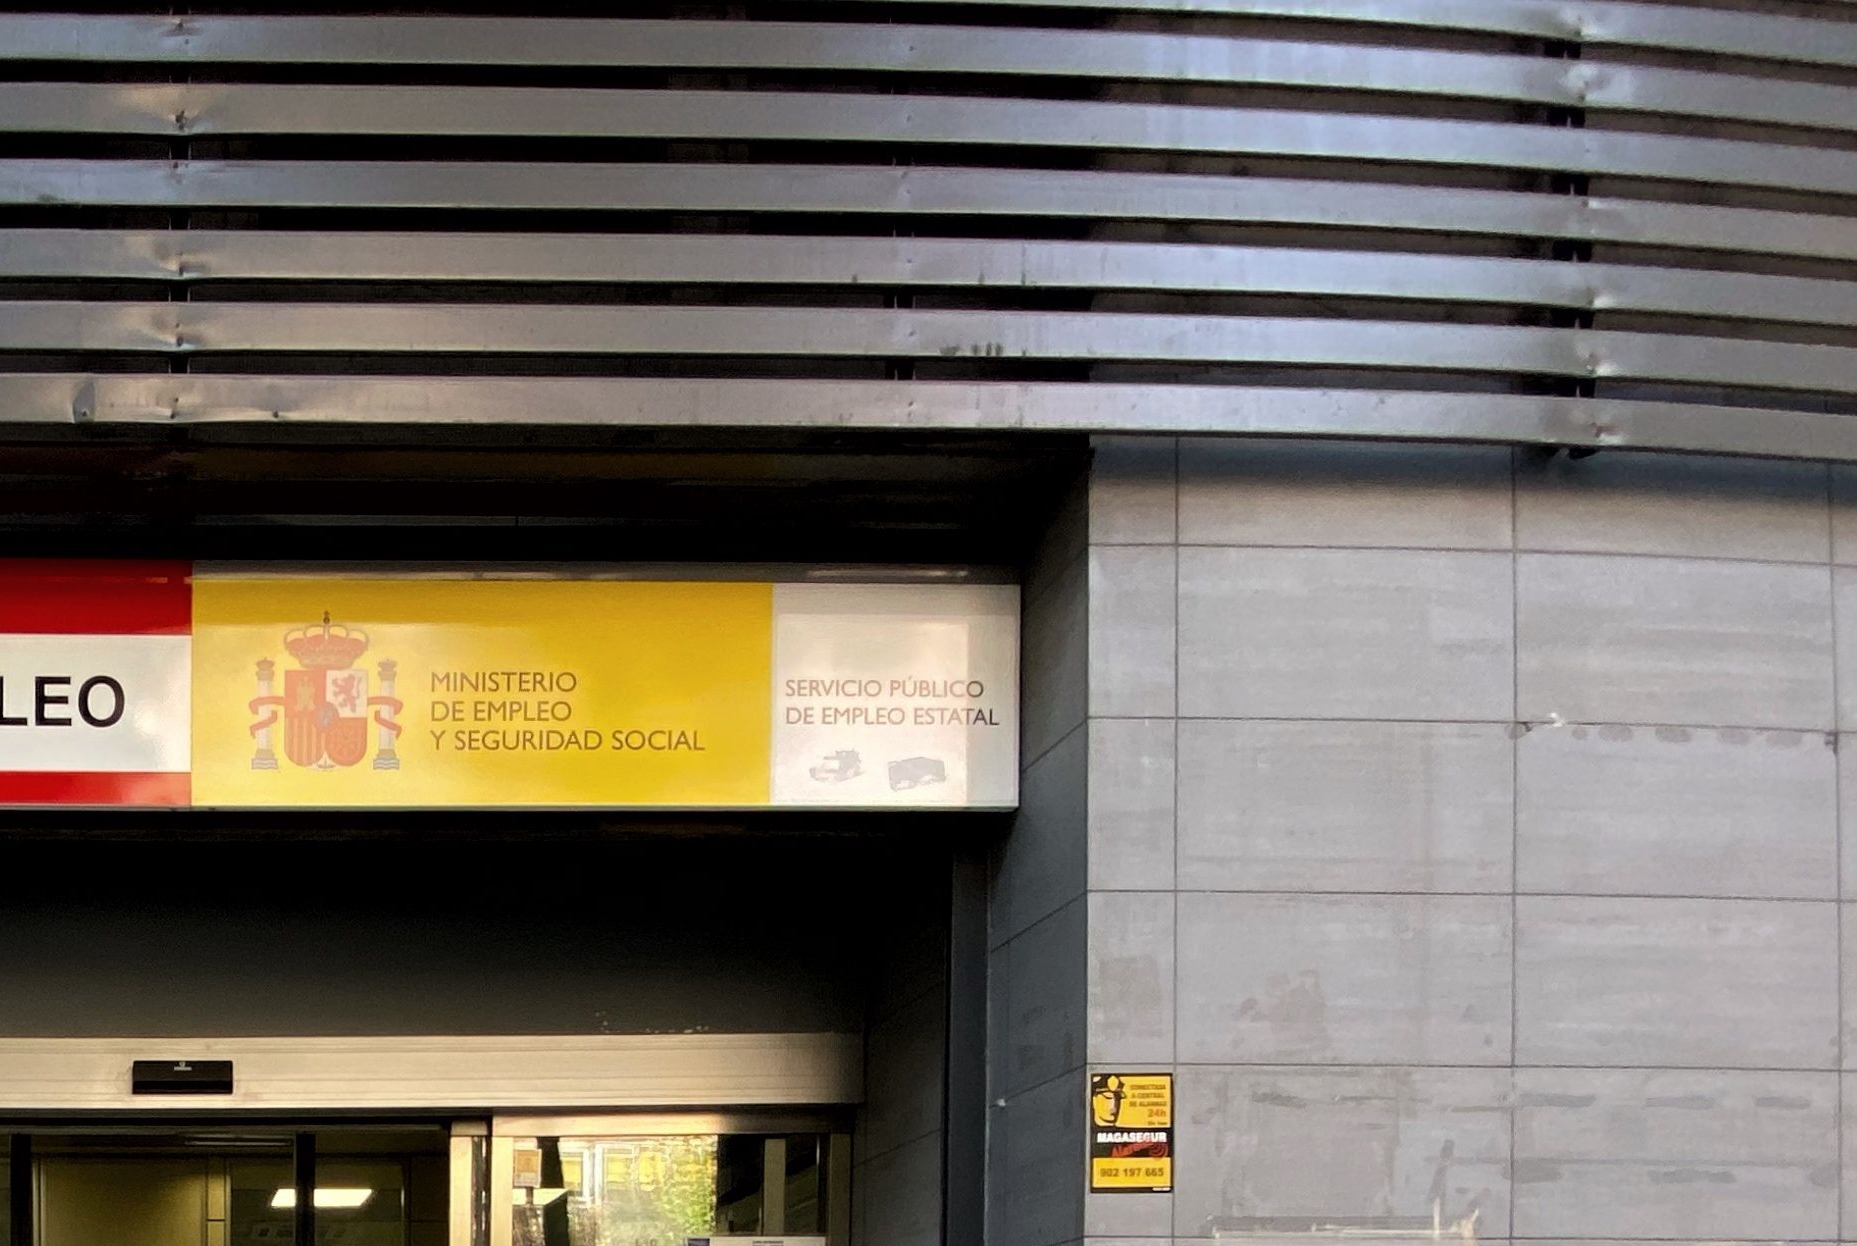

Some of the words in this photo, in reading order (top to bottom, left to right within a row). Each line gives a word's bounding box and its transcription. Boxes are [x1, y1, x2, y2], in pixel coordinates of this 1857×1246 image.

[430, 671, 578, 694] MINISTERIO
[785, 678, 883, 698] SERVICIO
[888, 675, 985, 699] PÚBLICO
[431, 701, 469, 722] DE
[473, 701, 572, 722] EMPLEO
[786, 706, 814, 726] DE
[819, 706, 906, 726] EMPLEO
[913, 707, 1001, 727] ESTATAL
[430, 731, 446, 751] Y
[454, 729, 603, 752] SEGURIDAD
[611, 730, 705, 752] SOCIAL
[1147, 1108, 1167, 1117] 24h
[1097, 1132, 1167, 1143] MAGASEGUR
[1100, 1168, 1119, 1177] 902
[1123, 1168, 1141, 1177] 197
